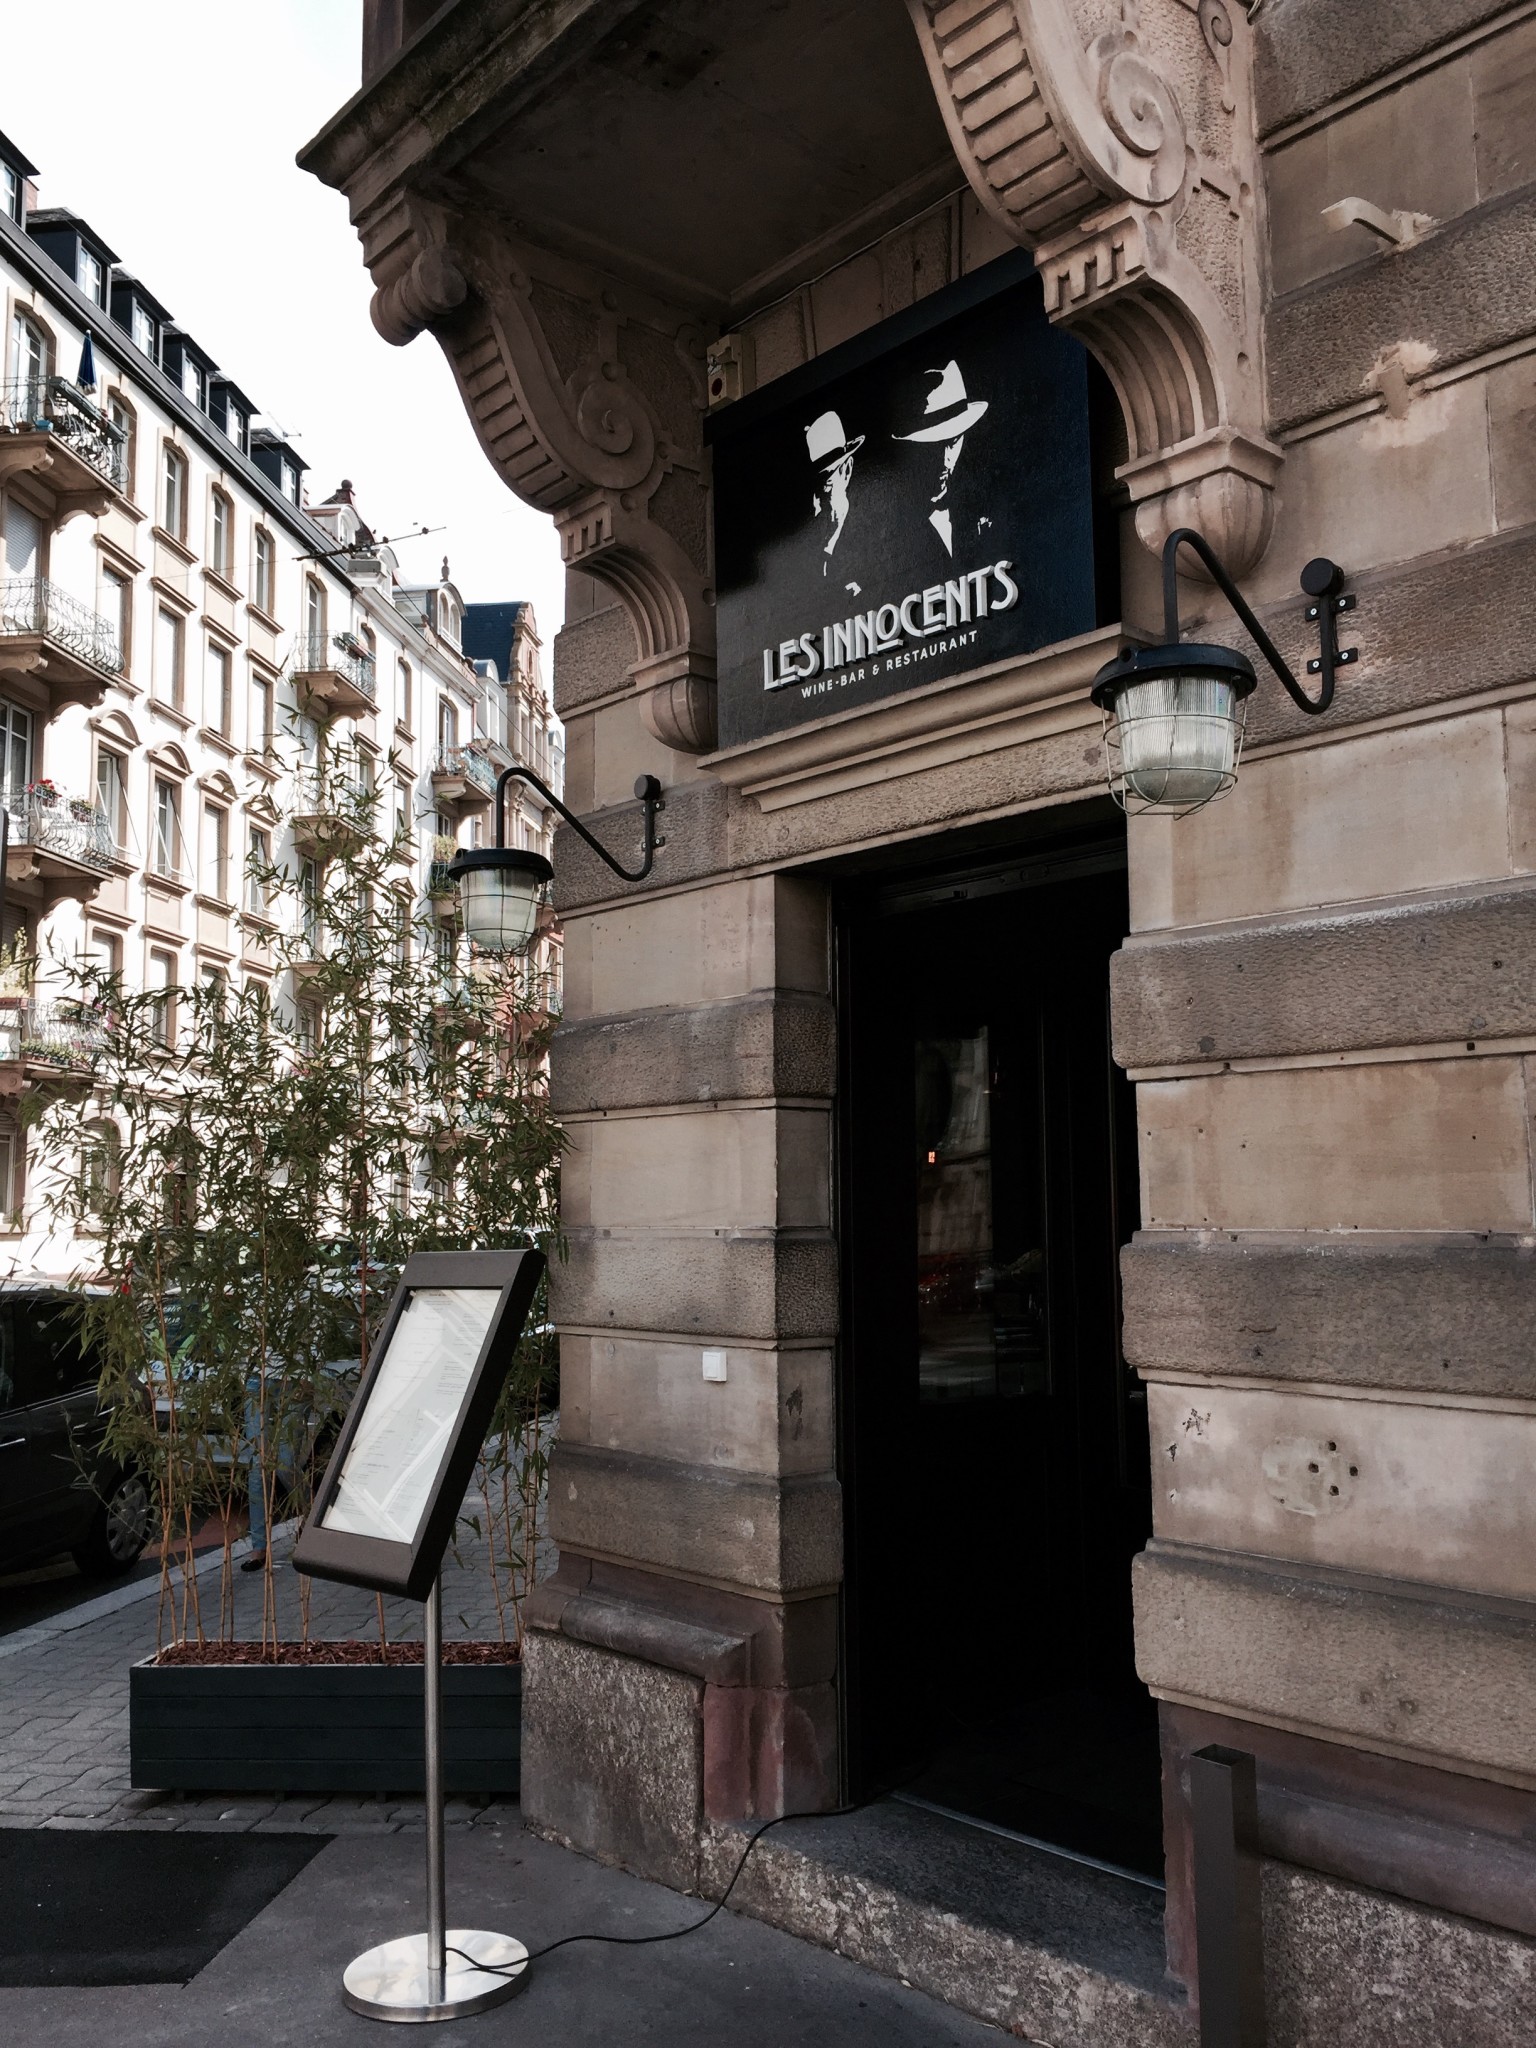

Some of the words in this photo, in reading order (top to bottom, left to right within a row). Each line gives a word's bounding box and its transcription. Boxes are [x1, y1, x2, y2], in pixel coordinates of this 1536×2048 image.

[763, 633, 820, 691] LES
[823, 560, 1019, 670] INNOCENTS
[801, 669, 865, 698] WINE-BAR
[872, 664, 880, 676] &
[886, 630, 978, 671] RESTAURANT
